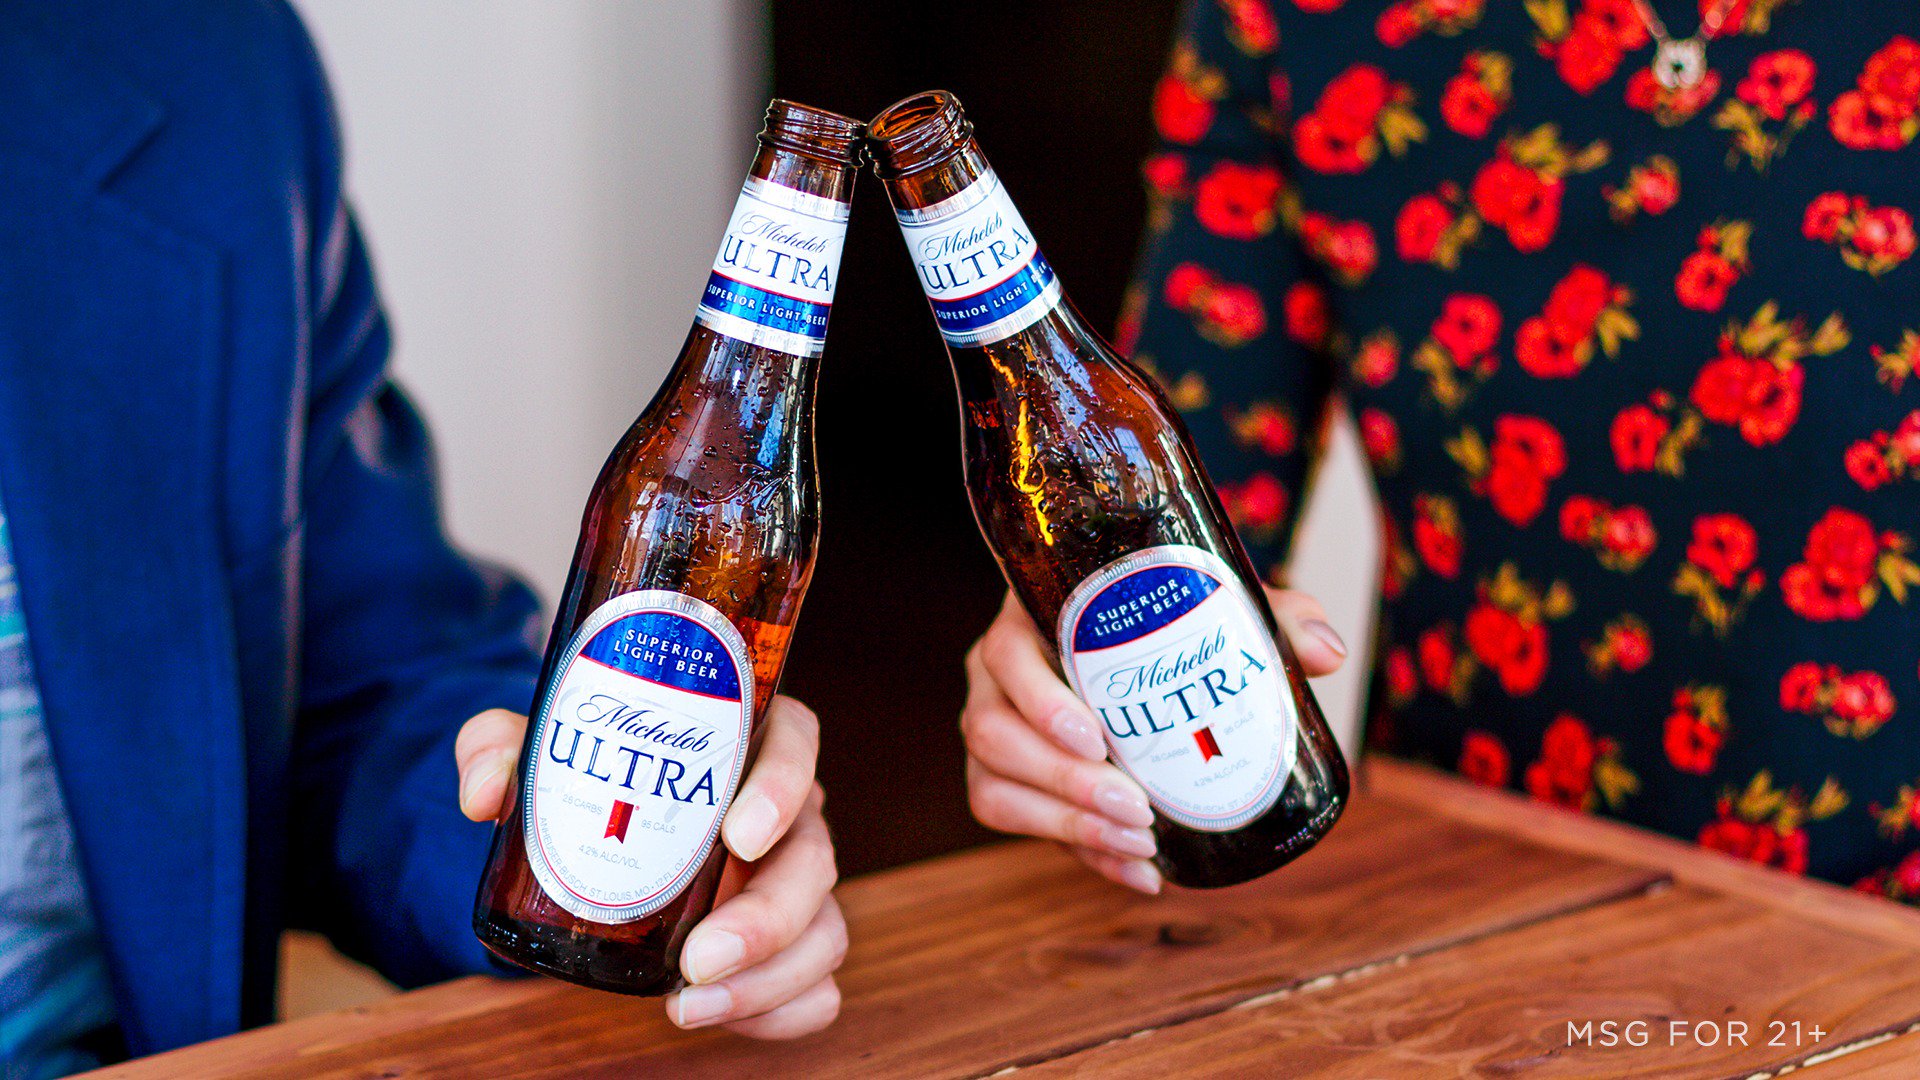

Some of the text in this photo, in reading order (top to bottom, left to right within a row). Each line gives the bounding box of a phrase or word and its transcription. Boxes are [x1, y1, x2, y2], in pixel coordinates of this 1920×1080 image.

[741, 214, 829, 254] Michelob
[920, 226, 1029, 290] ULTRA
[924, 211, 1003, 261] Michelob
[723, 234, 830, 292] ULTRA
[707, 283, 757, 310] SUPERIOR
[762, 303, 802, 322] LIGHT
[936, 304, 989, 320] SUPERIOR
[993, 281, 1029, 308] LIGHT
[1094, 586, 1192, 637] LIGHT BEER
[1096, 578, 1180, 624] SUPERIOR
[613, 641, 719, 680] LIGHT BEER
[625, 628, 715, 664] SUPERIOR
[1106, 624, 1227, 700] Michelob
[1096, 648, 1268, 739] ULTRA
[576, 694, 716, 753] Michelob
[549, 718, 718, 807] ULTRA
[574, 797, 604, 815] CARBS
[653, 821, 676, 834] CALS
